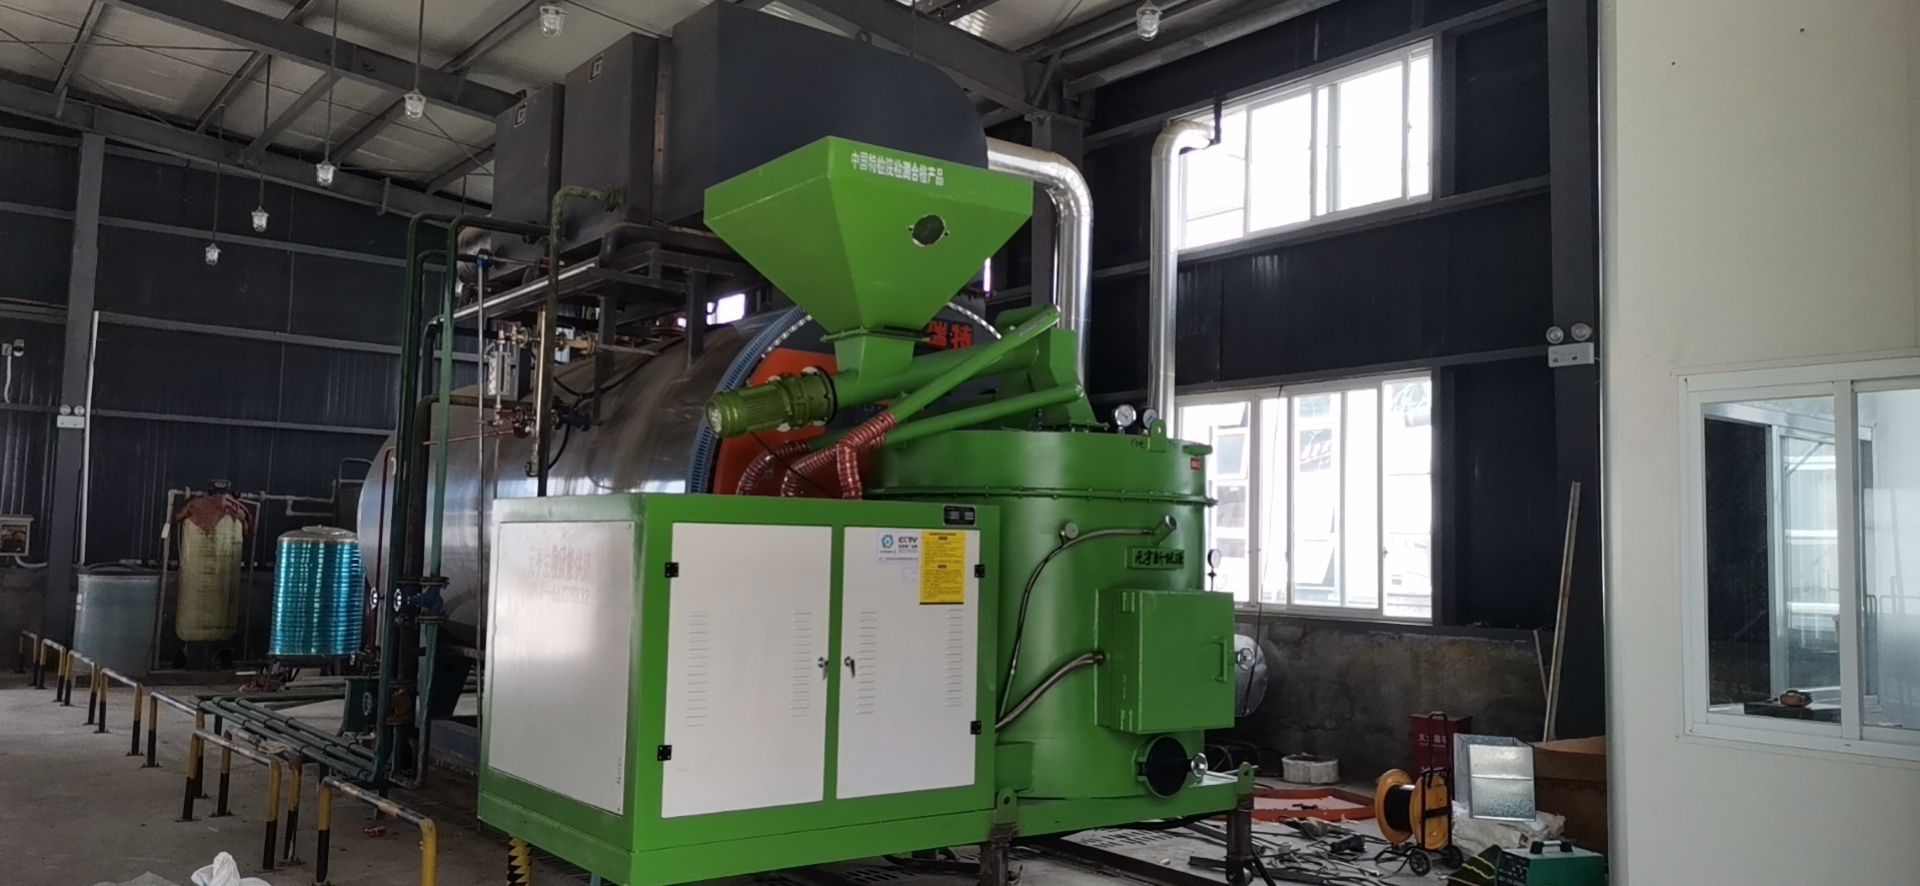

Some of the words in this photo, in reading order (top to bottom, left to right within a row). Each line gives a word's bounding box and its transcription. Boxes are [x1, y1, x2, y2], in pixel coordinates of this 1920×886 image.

[851, 150, 944, 186] 中国特检院检测合格产品
[898, 536, 918, 544] CCTV
